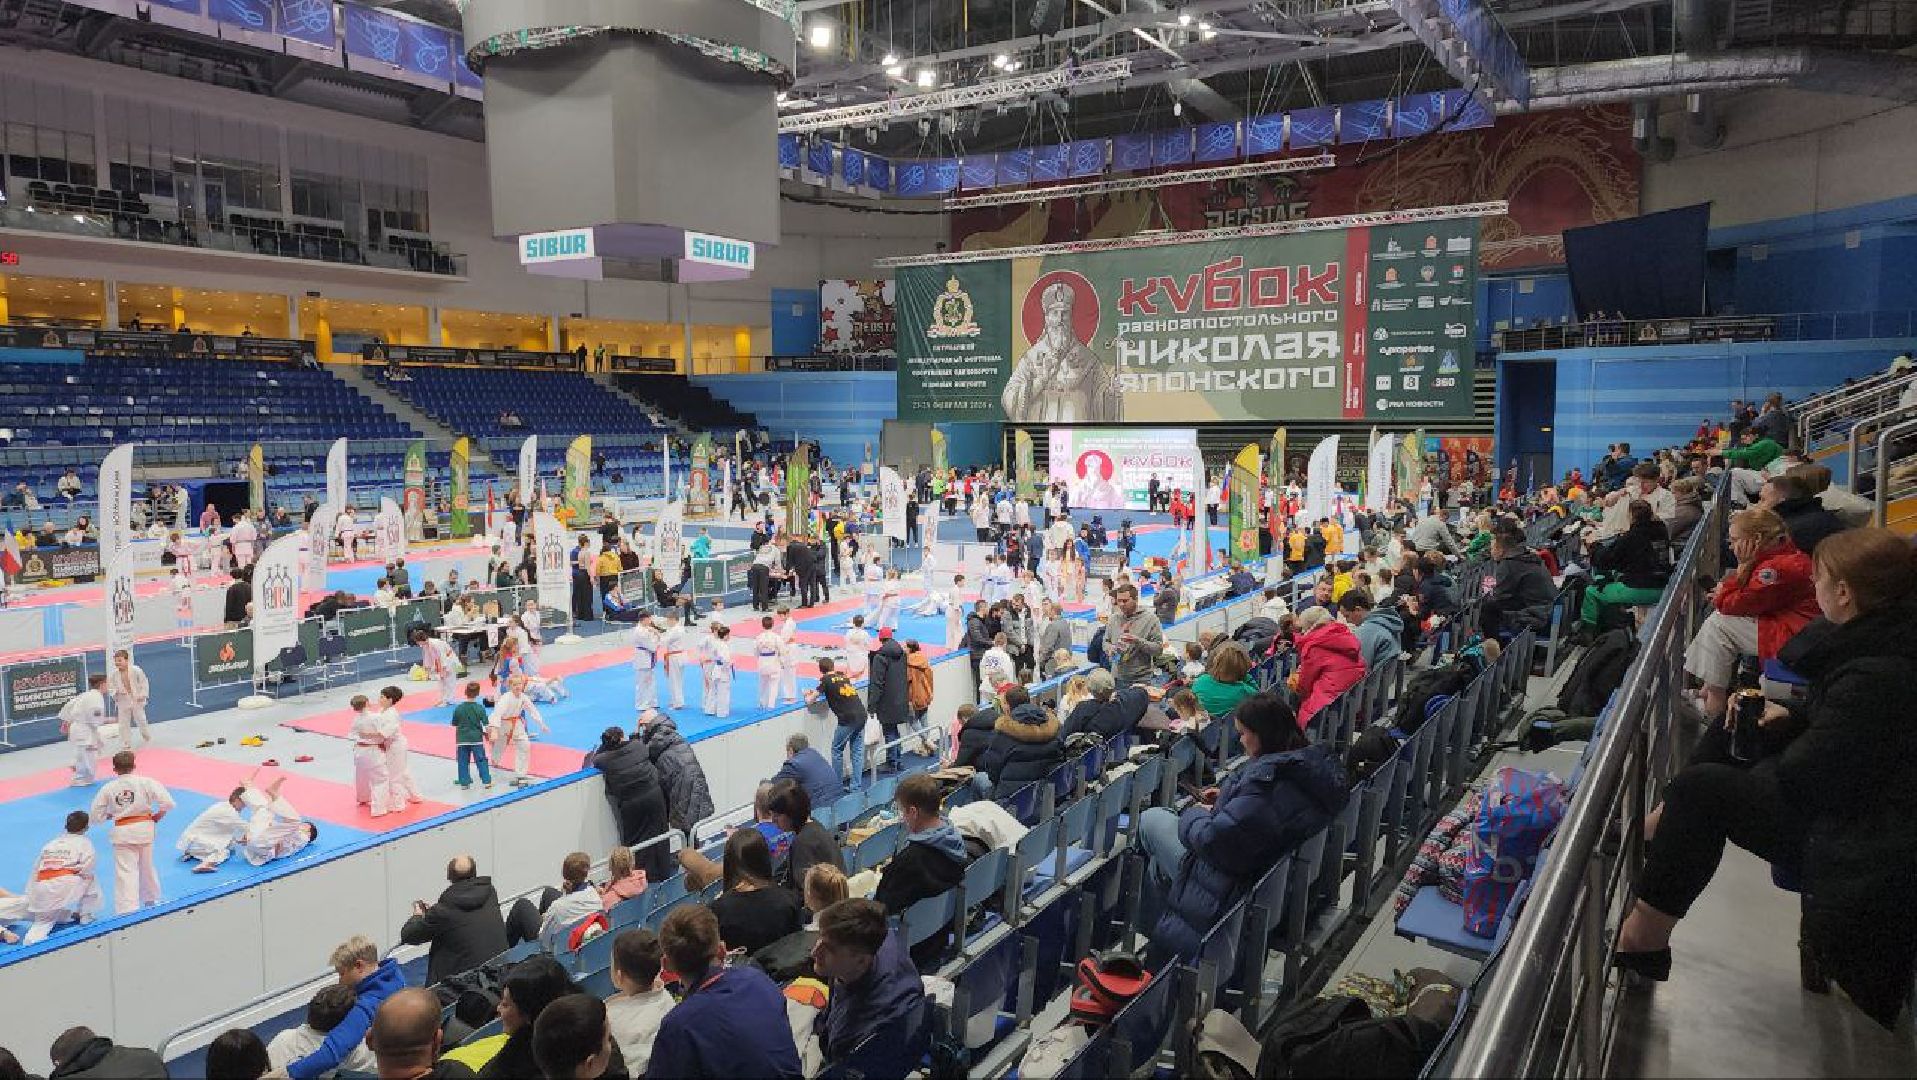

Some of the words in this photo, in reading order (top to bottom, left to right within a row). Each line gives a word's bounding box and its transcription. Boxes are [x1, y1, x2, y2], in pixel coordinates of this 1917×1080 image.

[526, 234, 586, 258] SIBUR
[692, 237, 749, 264] SIBUR
[1405, 399, 1444, 408] НОВОСТИ
